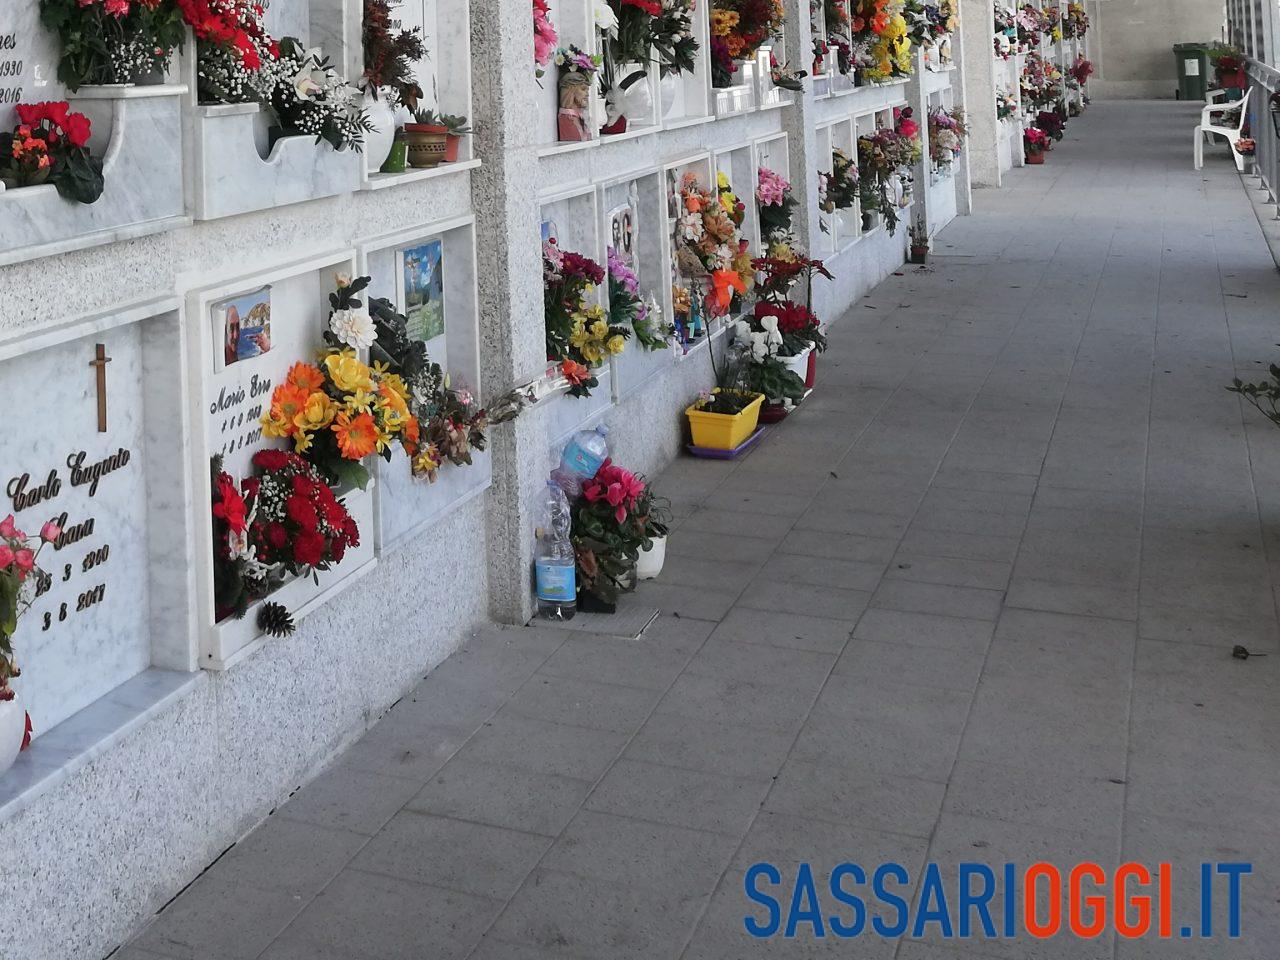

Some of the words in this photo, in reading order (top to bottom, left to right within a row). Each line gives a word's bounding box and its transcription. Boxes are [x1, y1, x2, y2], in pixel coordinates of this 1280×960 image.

[0, 60, 23, 77] 1930
[210, 387, 245, 415] Mario
[6, 469, 62, 512] Carlo
[66, 447, 131, 497] Eugenio
[62, 563, 72, 582] 3
[42, 611, 52, 631] 3
[59, 602, 68, 621] 8
[76, 583, 106, 612] 2017
